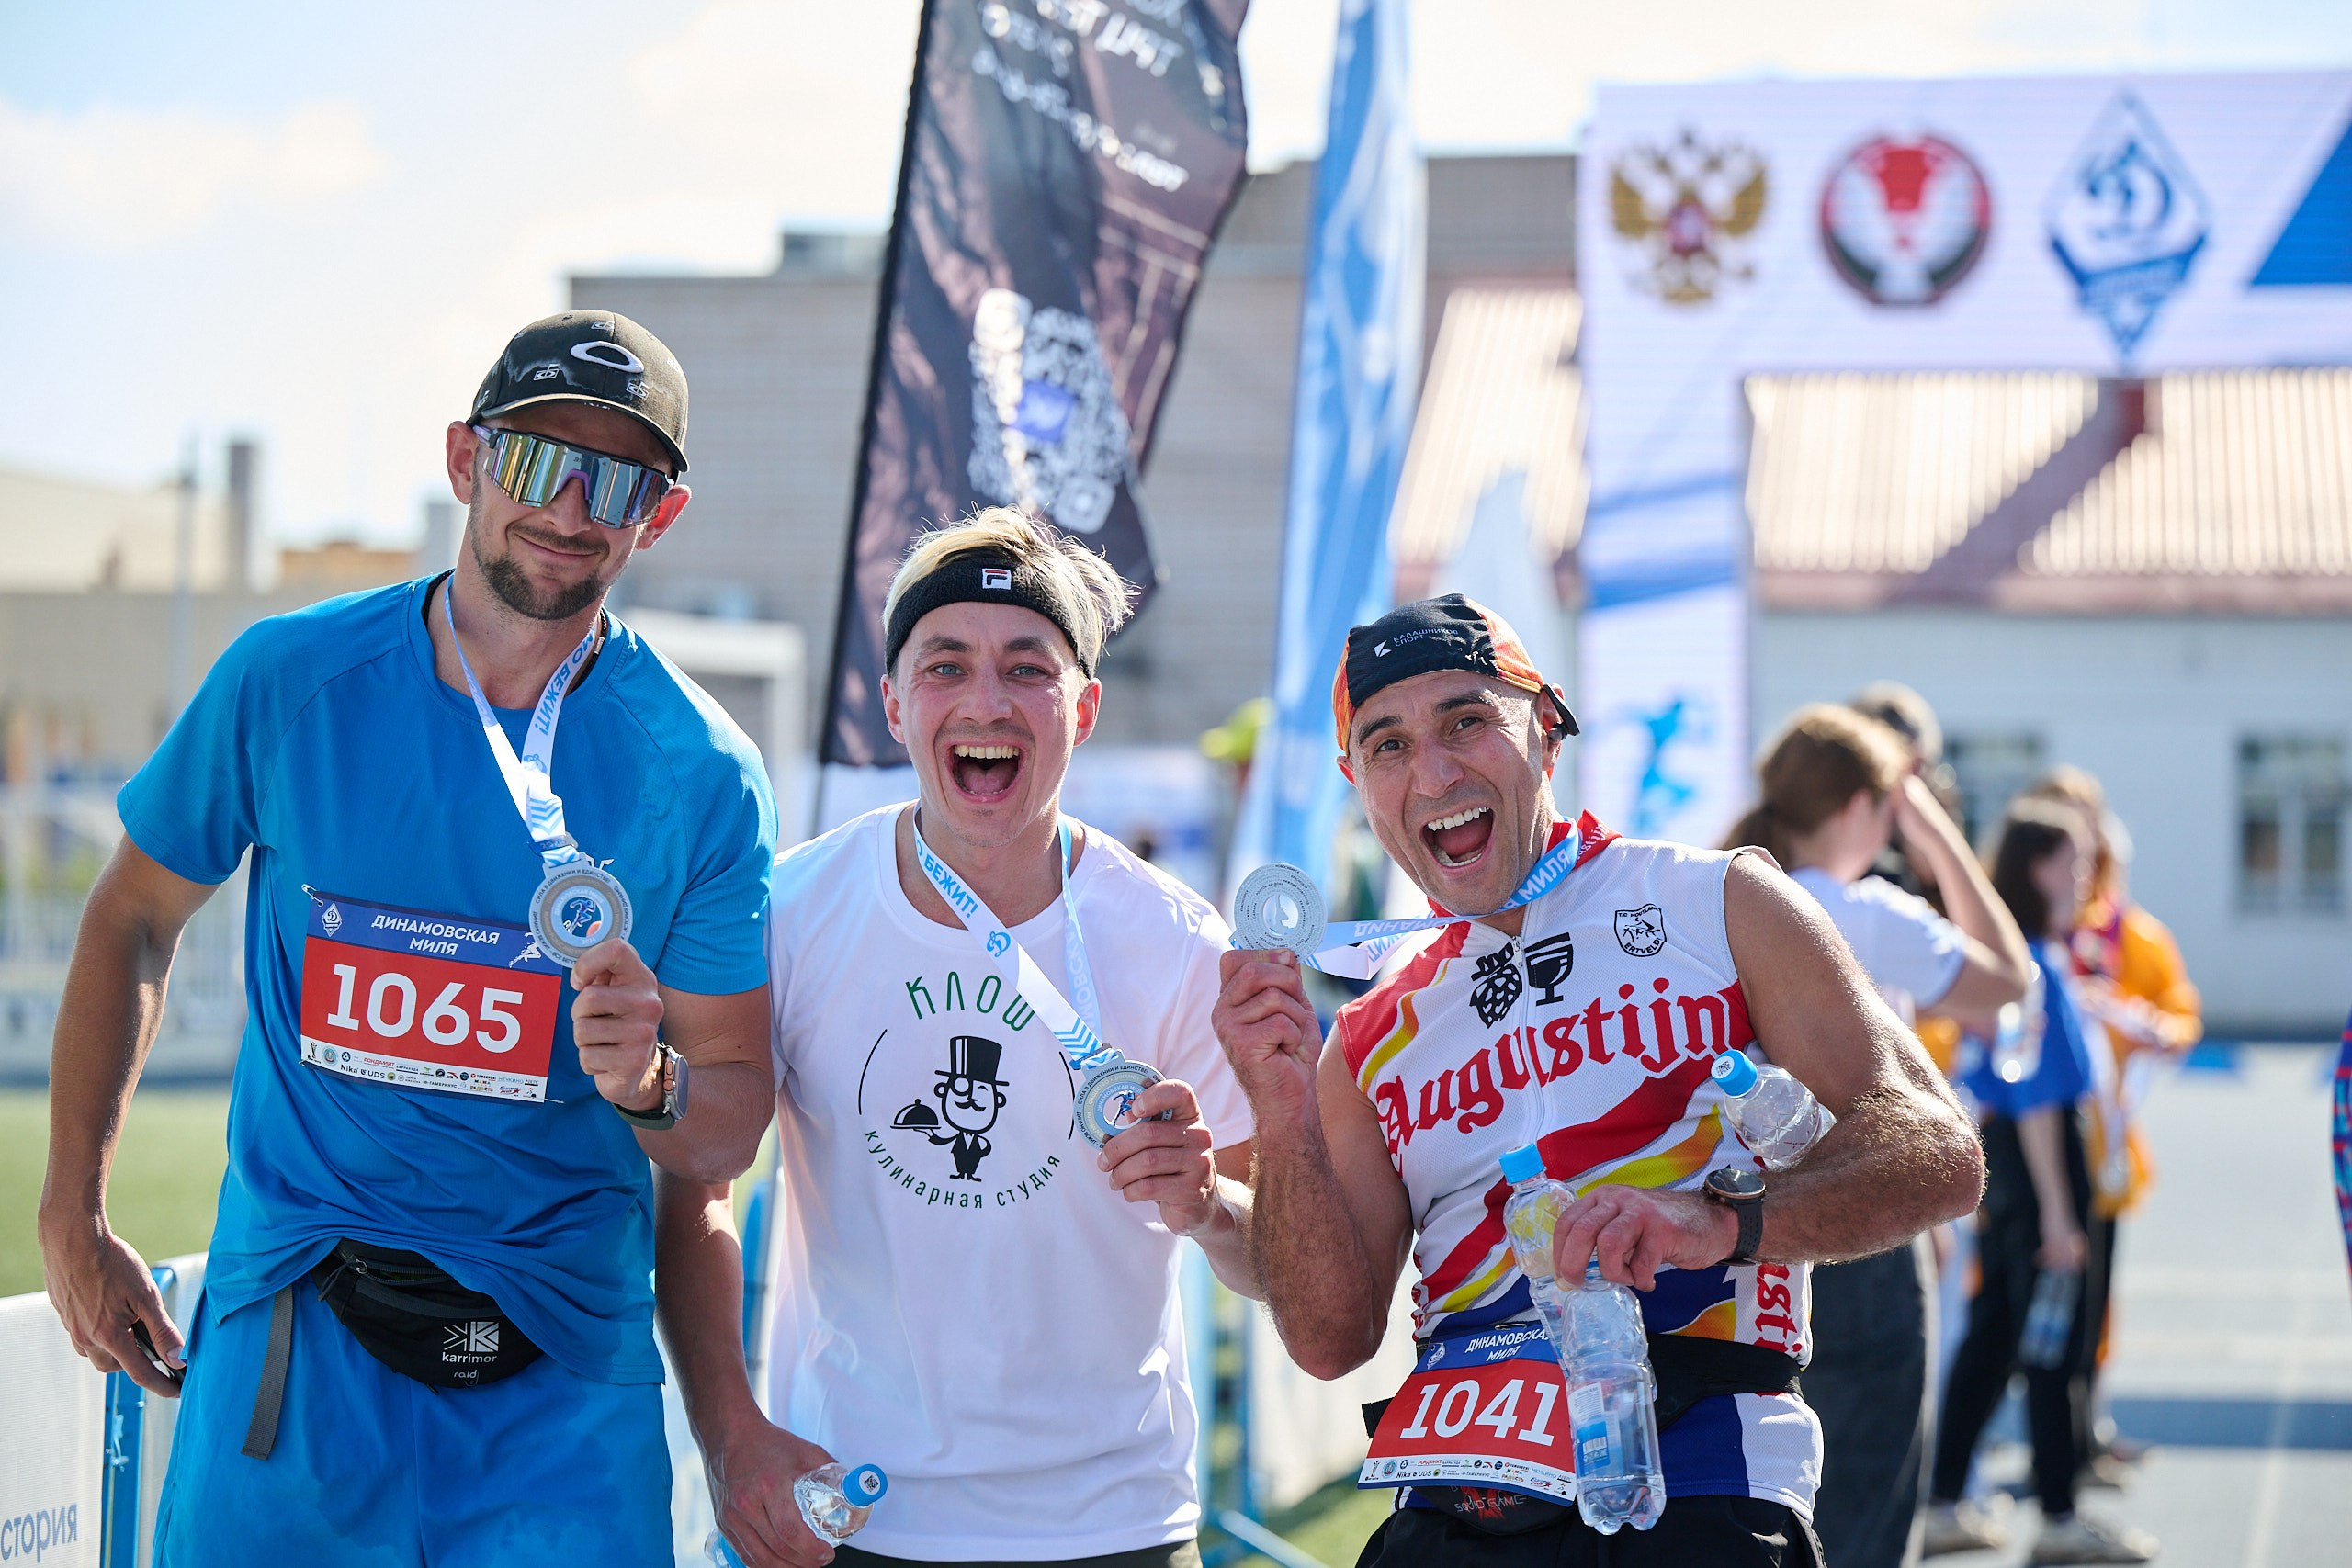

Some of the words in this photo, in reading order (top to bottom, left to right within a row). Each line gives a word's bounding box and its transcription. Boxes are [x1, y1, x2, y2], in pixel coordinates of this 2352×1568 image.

[1393, 628, 1459, 642] КАЛАШНИКОВ
[1395, 635, 1424, 647] СПОРТ
[535, 662, 571, 735] БЕЖИТ!
[924, 854, 978, 919] БЕЖИТ!
[1518, 848, 1571, 901] МИЛЯ
[536, 889, 545, 904] СИЛА
[371, 914, 501, 945] ДИНАМОВСКАЯ
[409, 937, 458, 956] МИЛЯ
[327, 963, 524, 1054] 1065
[906, 971, 1035, 1032] КЛОШ
[368, 1070, 386, 1079] UDS
[1376, 977, 1731, 1154] Augustijn
[1078, 1089, 1088, 1105] СИЛА
[1088, 1067, 1114, 1087] ДВИЖЕНИИ
[1120, 1065, 1149, 1074] ЕДИНСТВЕ!
[865, 1130, 983, 1208] кулинарная
[997, 1154, 1061, 1207] студия
[442, 1351, 498, 1363] karrimor
[1486, 1346, 1521, 1362] МИЛЯ
[453, 1369, 478, 1380] raid
[1399, 1379, 1560, 1447] 1041
